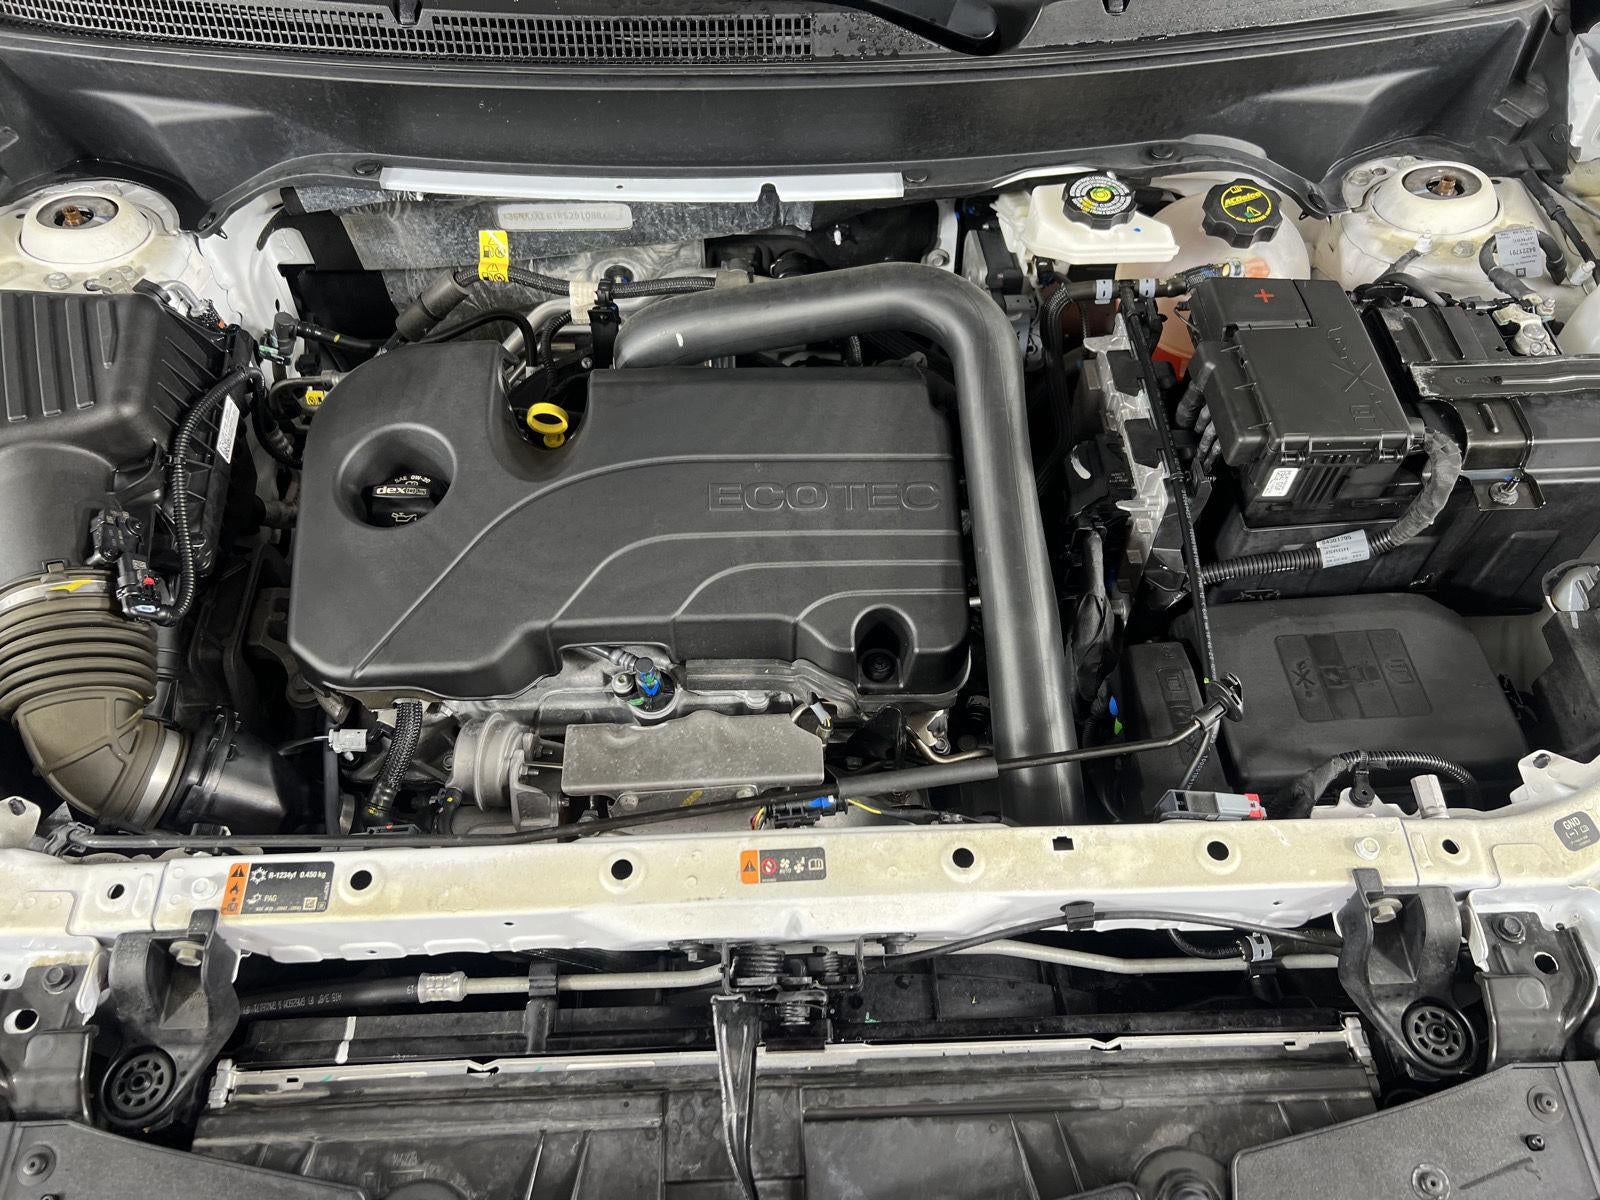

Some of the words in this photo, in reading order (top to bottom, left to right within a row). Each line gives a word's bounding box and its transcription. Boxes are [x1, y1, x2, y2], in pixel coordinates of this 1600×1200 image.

[1225, 192, 1262, 206] ACDelco
[411, 475, 431, 484] 0W-20
[376, 487, 427, 495] dexos
[708, 482, 942, 512] ECOTEC
[1563, 817, 1580, 829] GND
[268, 871, 297, 880] R-1234yf
[299, 871, 317, 879] 0.450
[317, 870, 327, 879] kg
[264, 894, 278, 902] PAG
